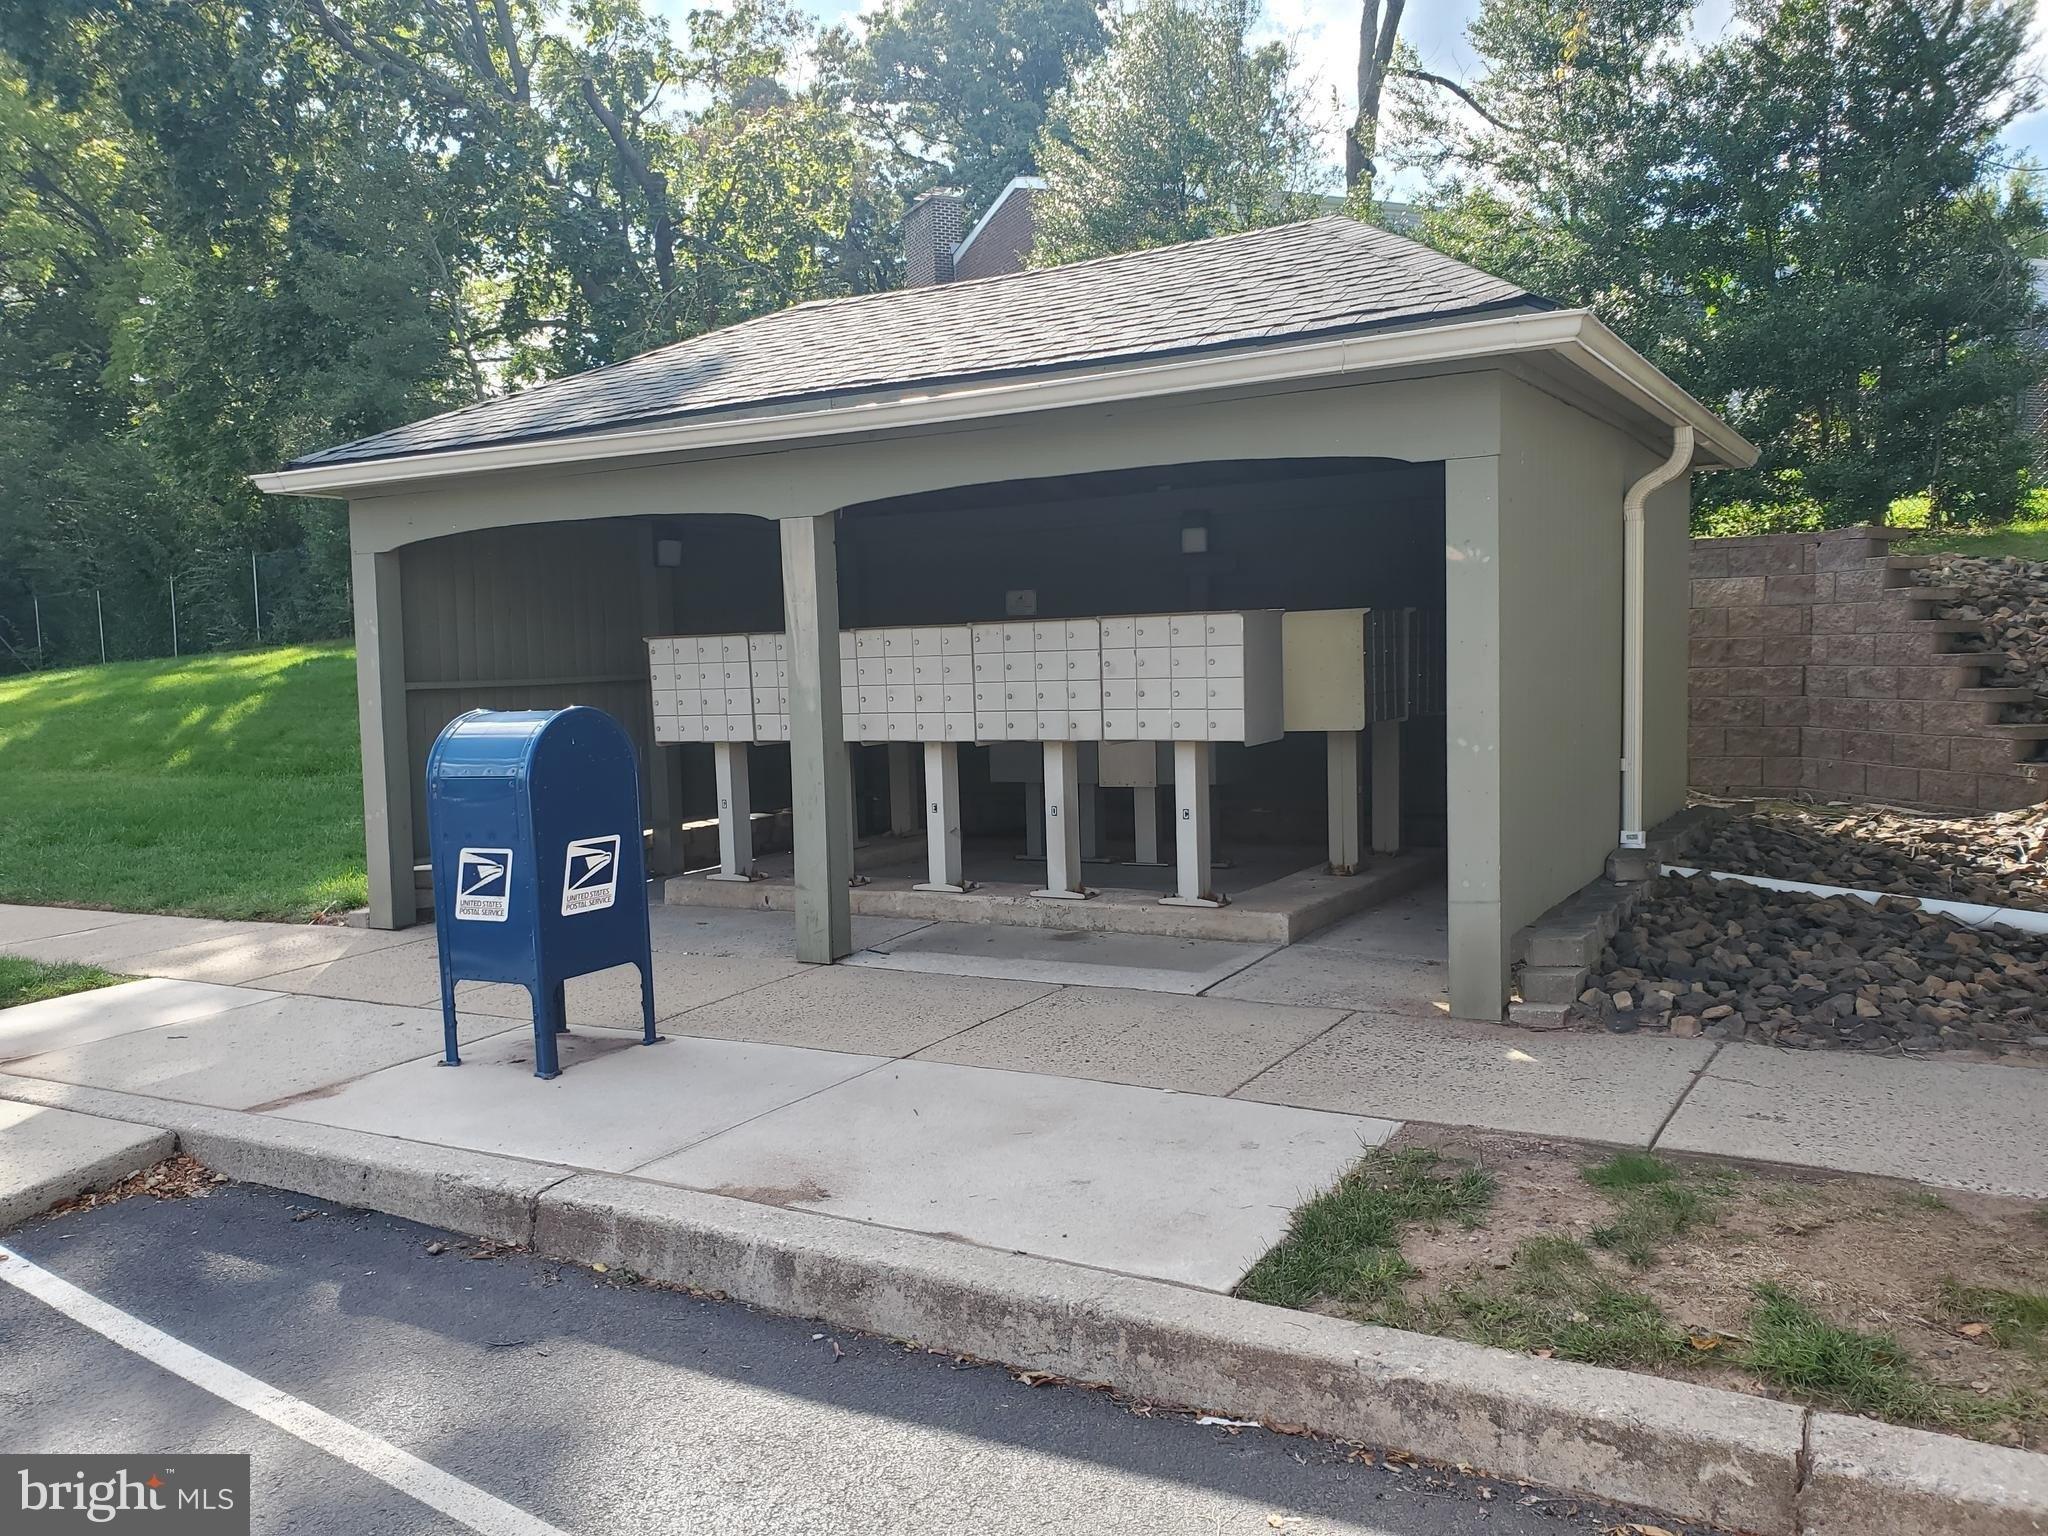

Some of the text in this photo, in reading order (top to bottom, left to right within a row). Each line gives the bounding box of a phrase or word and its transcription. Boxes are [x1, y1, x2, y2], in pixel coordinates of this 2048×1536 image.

[566, 888, 610, 902] UNITED STATES
[566, 896, 612, 910] POSTAL SERVICE
[481, 909, 504, 917] SERVICE
